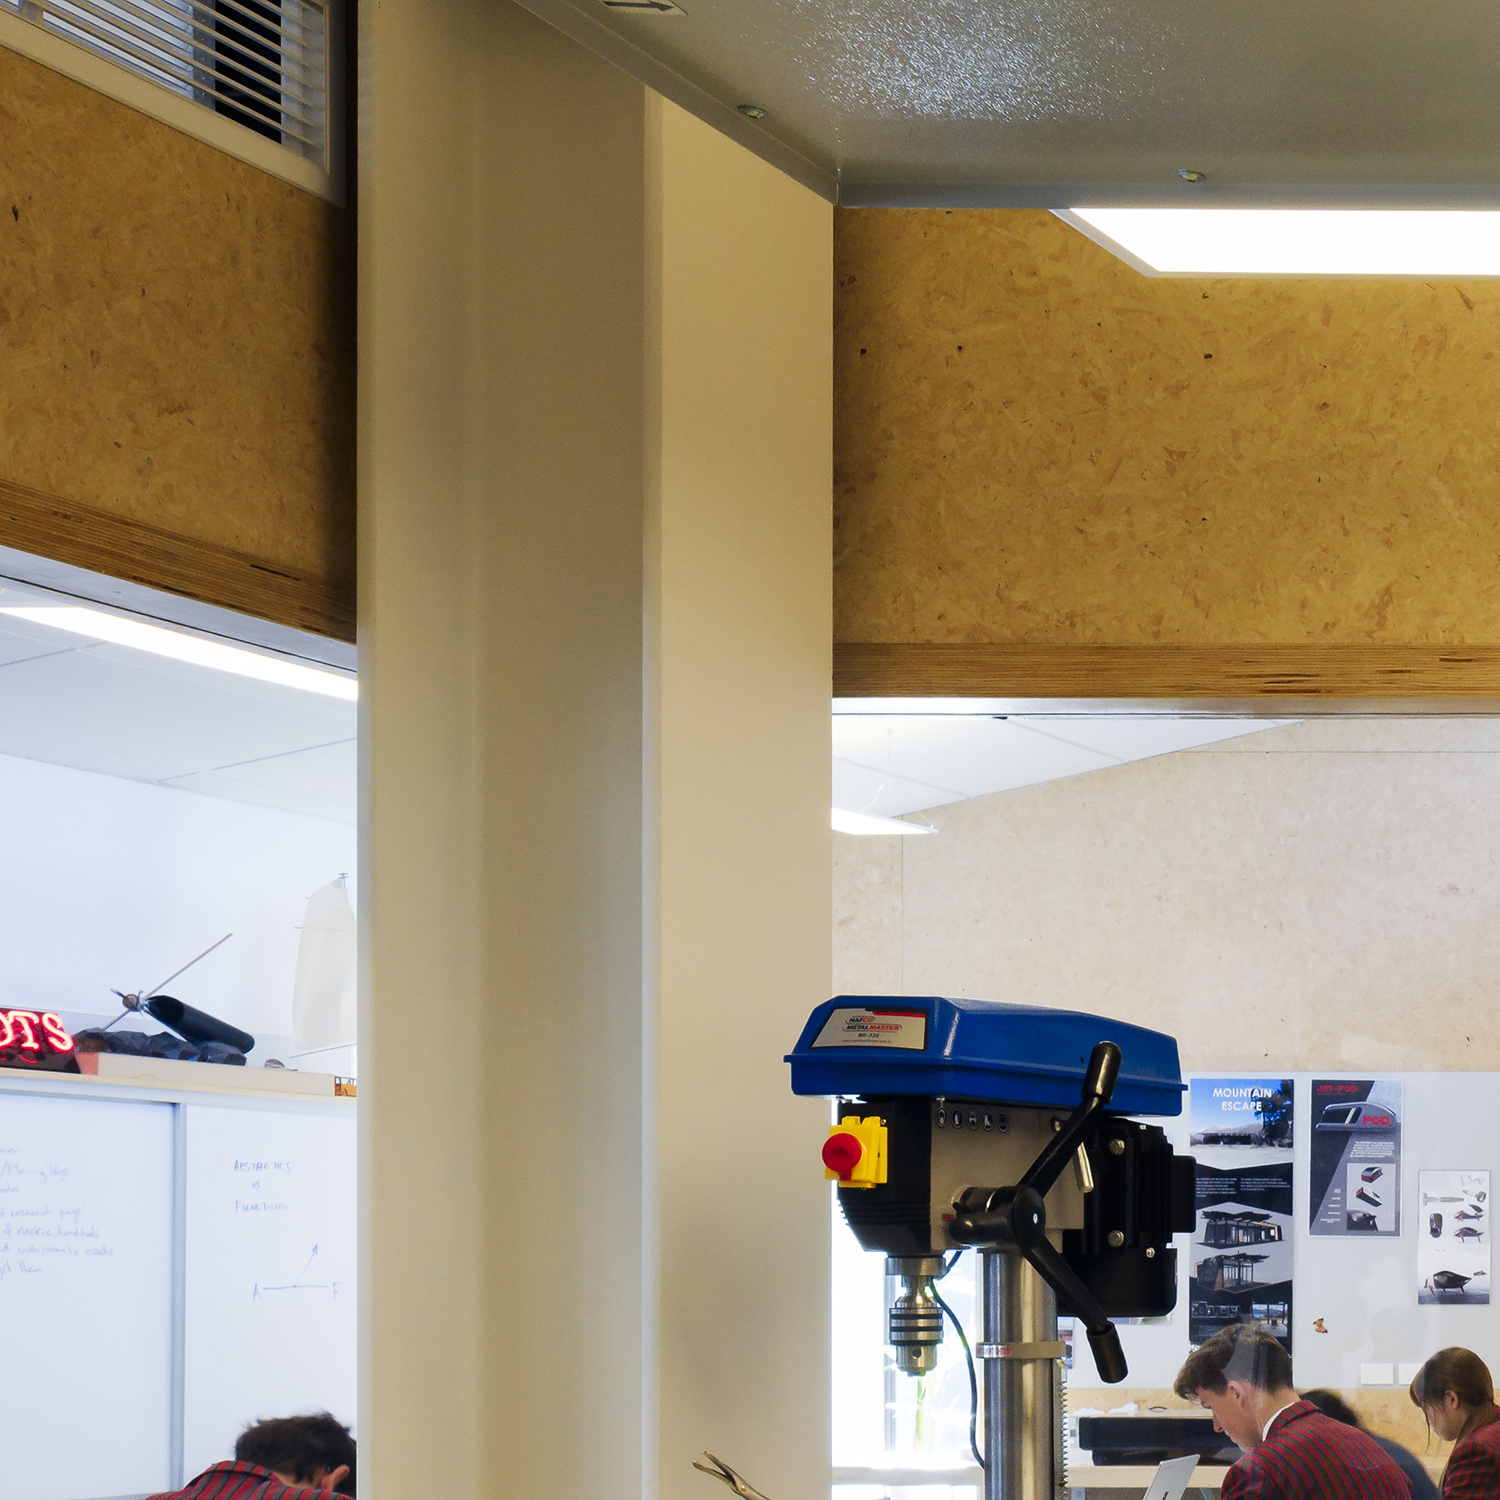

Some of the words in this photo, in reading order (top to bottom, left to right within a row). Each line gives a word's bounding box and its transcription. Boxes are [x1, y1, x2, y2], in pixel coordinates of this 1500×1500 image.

[1212, 1088, 1272, 1098] MOUNTAIN
[1221, 1101, 1262, 1111] ESCAPE
[1362, 1116, 1391, 1126] POD
